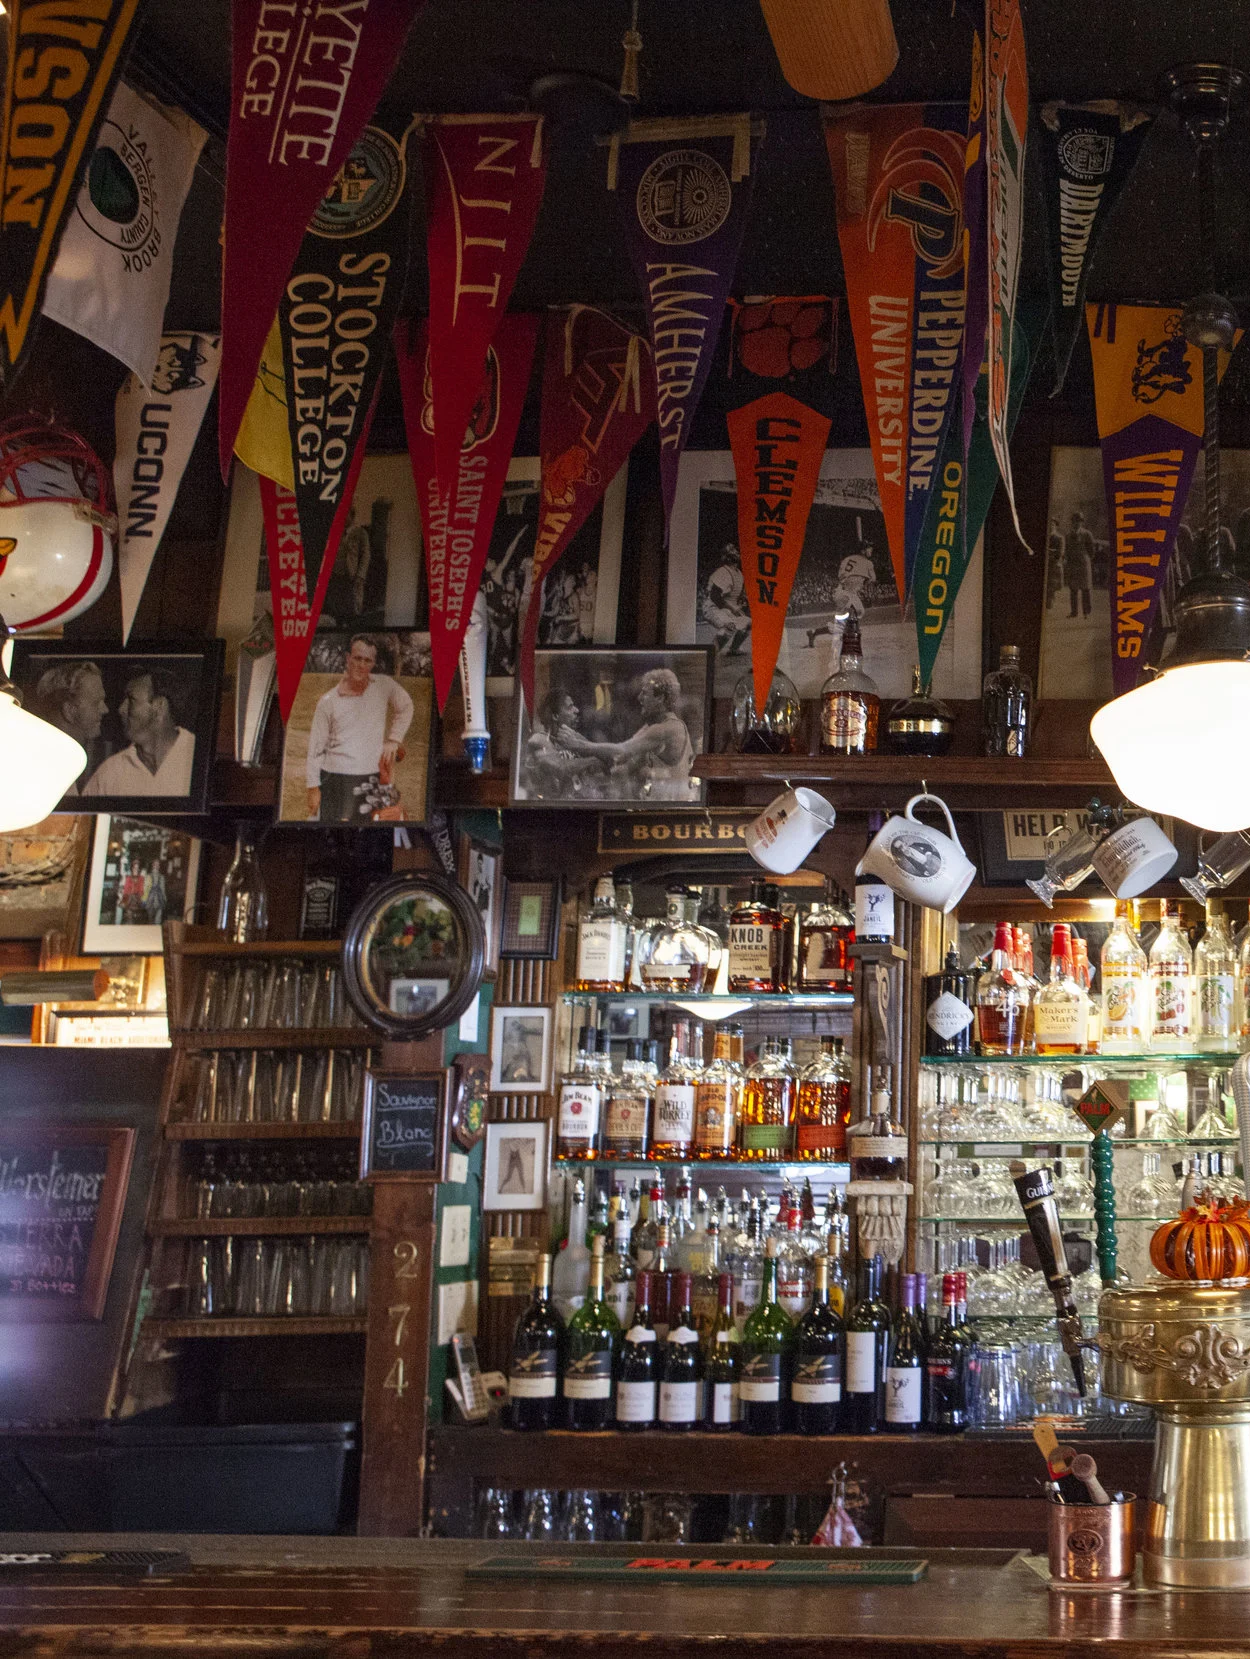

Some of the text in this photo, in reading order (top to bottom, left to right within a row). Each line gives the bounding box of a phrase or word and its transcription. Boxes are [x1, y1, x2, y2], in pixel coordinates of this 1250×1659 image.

[278, 0, 368, 167] YETTE
[119, 142, 151, 245] BERGEN COUNTY
[122, 228, 162, 274] BROOK
[455, 134, 520, 308] NJIT
[1059, 178, 1104, 307] DARTMOUTH
[286, 272, 334, 486] COLLEGE
[319, 252, 391, 505] STOCKTON
[645, 262, 719, 450] AMHERST
[868, 294, 909, 487] UNIVERSITY
[908, 290, 967, 496] PEPPERDINE
[125, 402, 173, 538] UCONN
[445, 453, 490, 632] SAINT JOSEPH'S
[756, 417, 801, 606] CLEMSON
[274, 486, 302, 640] UCKEYES
[923, 461, 962, 636] OREGON
[1114, 449, 1184, 660] WILLIAMS
[1013, 814, 1065, 837] HELP
[730, 928, 763, 944] KNOB
[378, 1120, 434, 1143] Blanc
[658, 1108, 692, 1121] TURKEY
[662, 1099, 687, 1109] WILD
[1079, 1102, 1111, 1116] PALM
[626, 1558, 776, 1570] PALM
